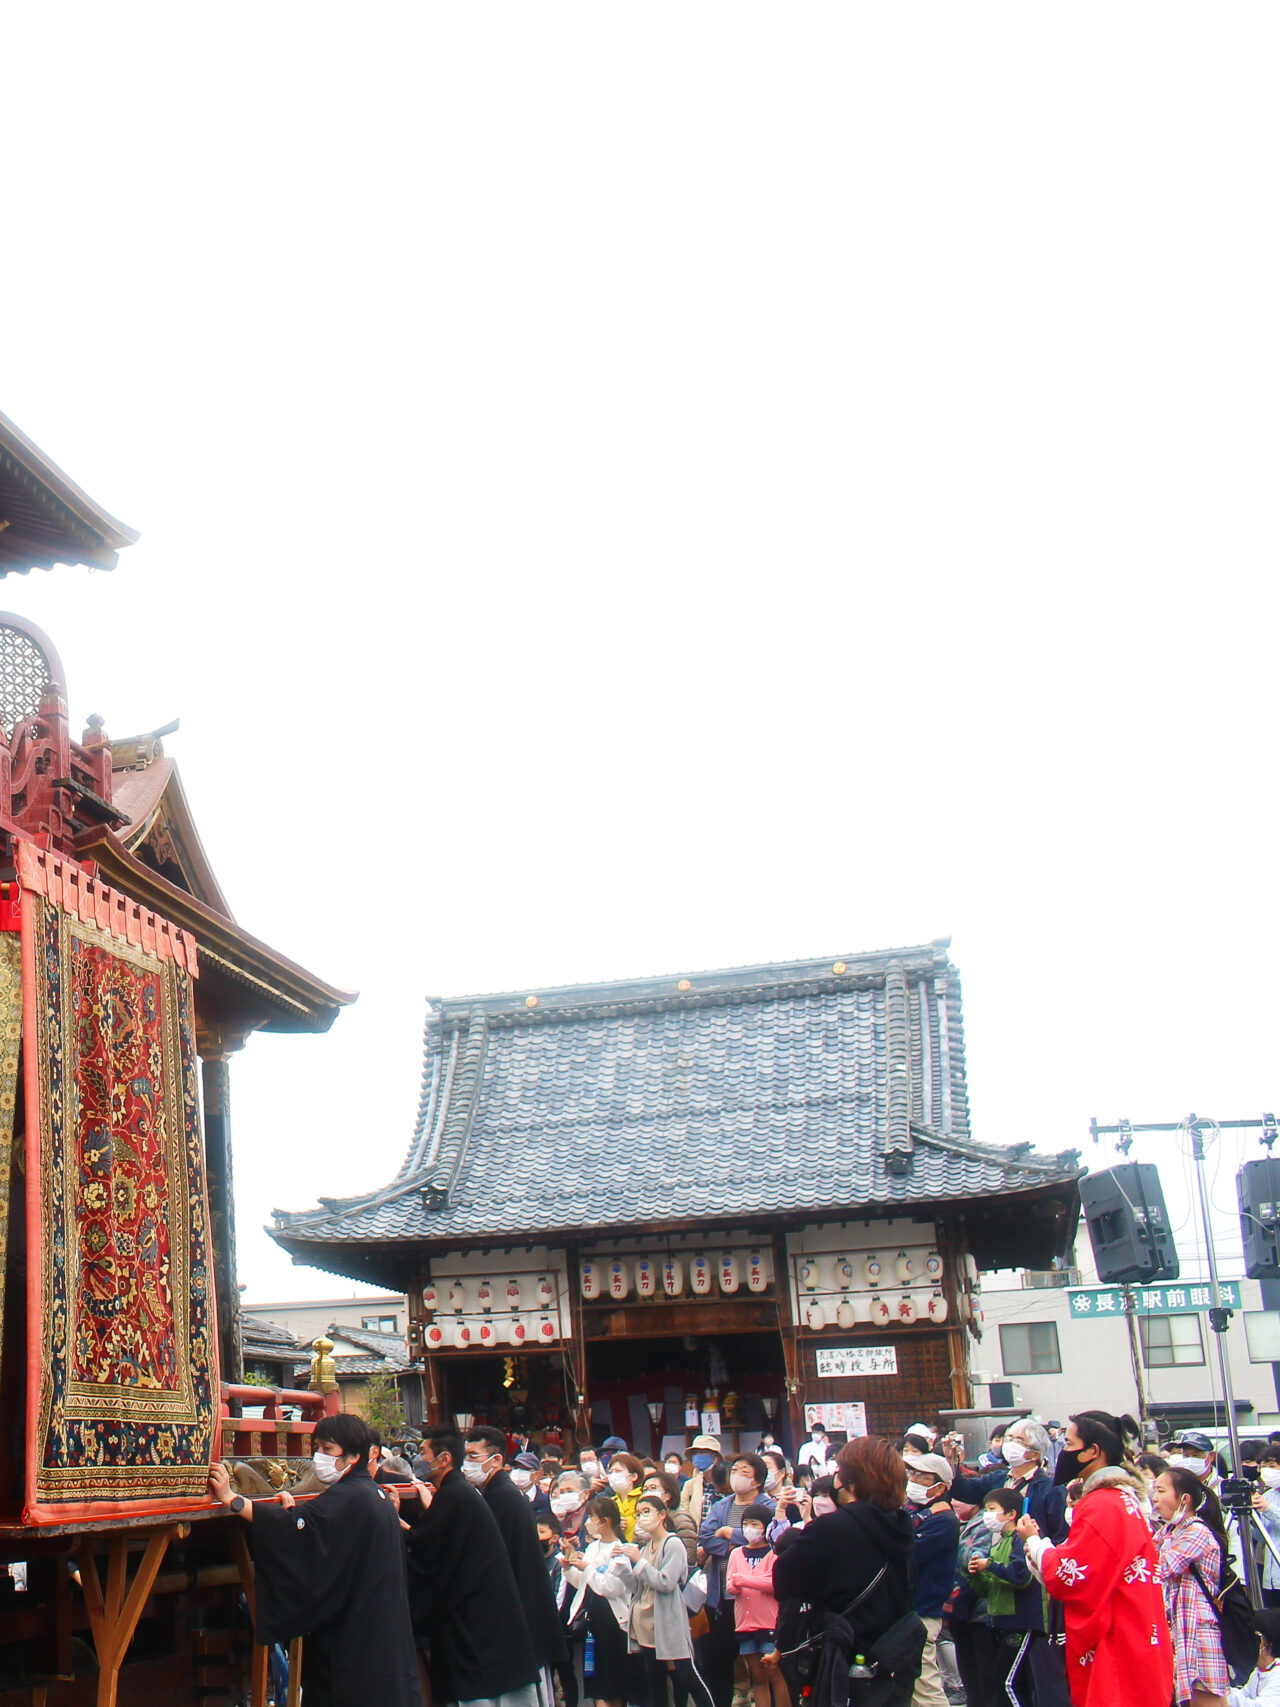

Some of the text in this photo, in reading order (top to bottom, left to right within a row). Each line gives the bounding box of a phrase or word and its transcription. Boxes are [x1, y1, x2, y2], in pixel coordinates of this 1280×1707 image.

[820, 1358, 895, 1374] 臨時授与所
